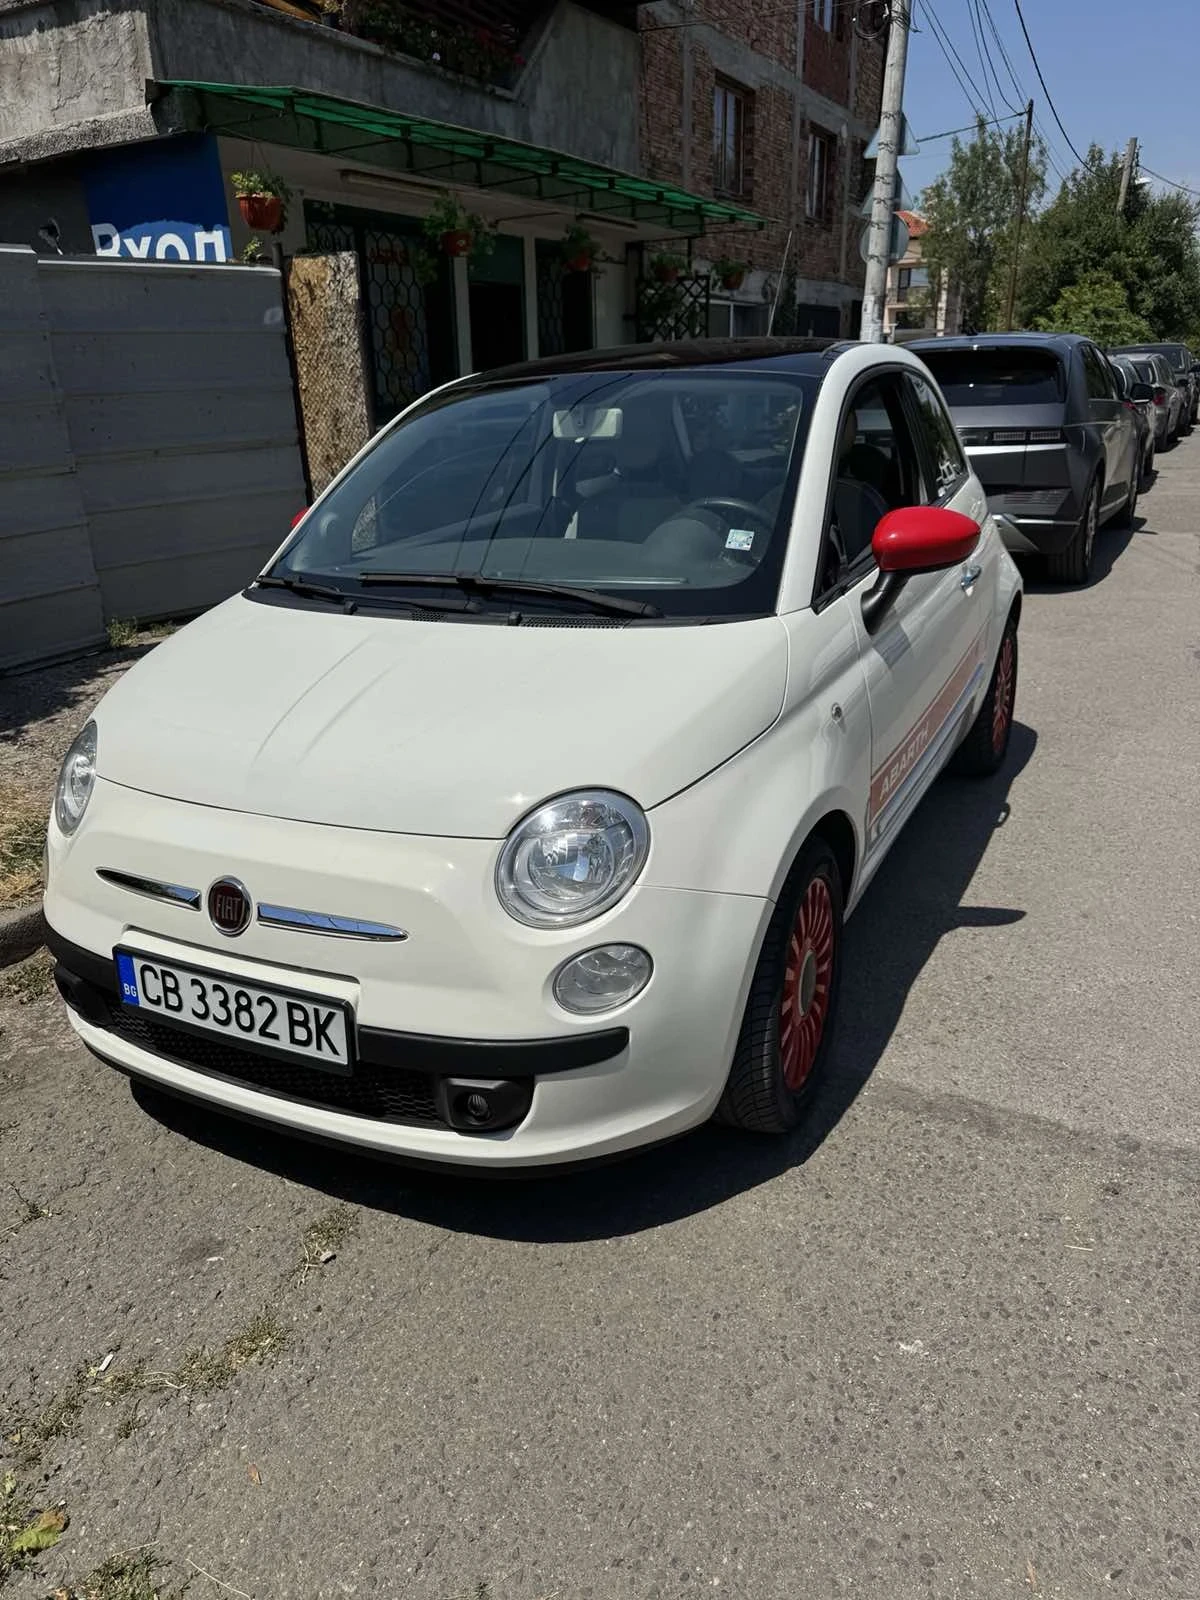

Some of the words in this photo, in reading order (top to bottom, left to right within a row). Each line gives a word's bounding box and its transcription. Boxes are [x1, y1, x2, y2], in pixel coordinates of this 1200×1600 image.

[880, 721, 928, 803] ABARTH
[216, 894, 241, 920] FIAT
[123, 983, 137, 997] BG
[140, 964, 183, 1012] CB
[190, 978, 280, 1042] 3382
[286, 1001, 340, 1056] BK
